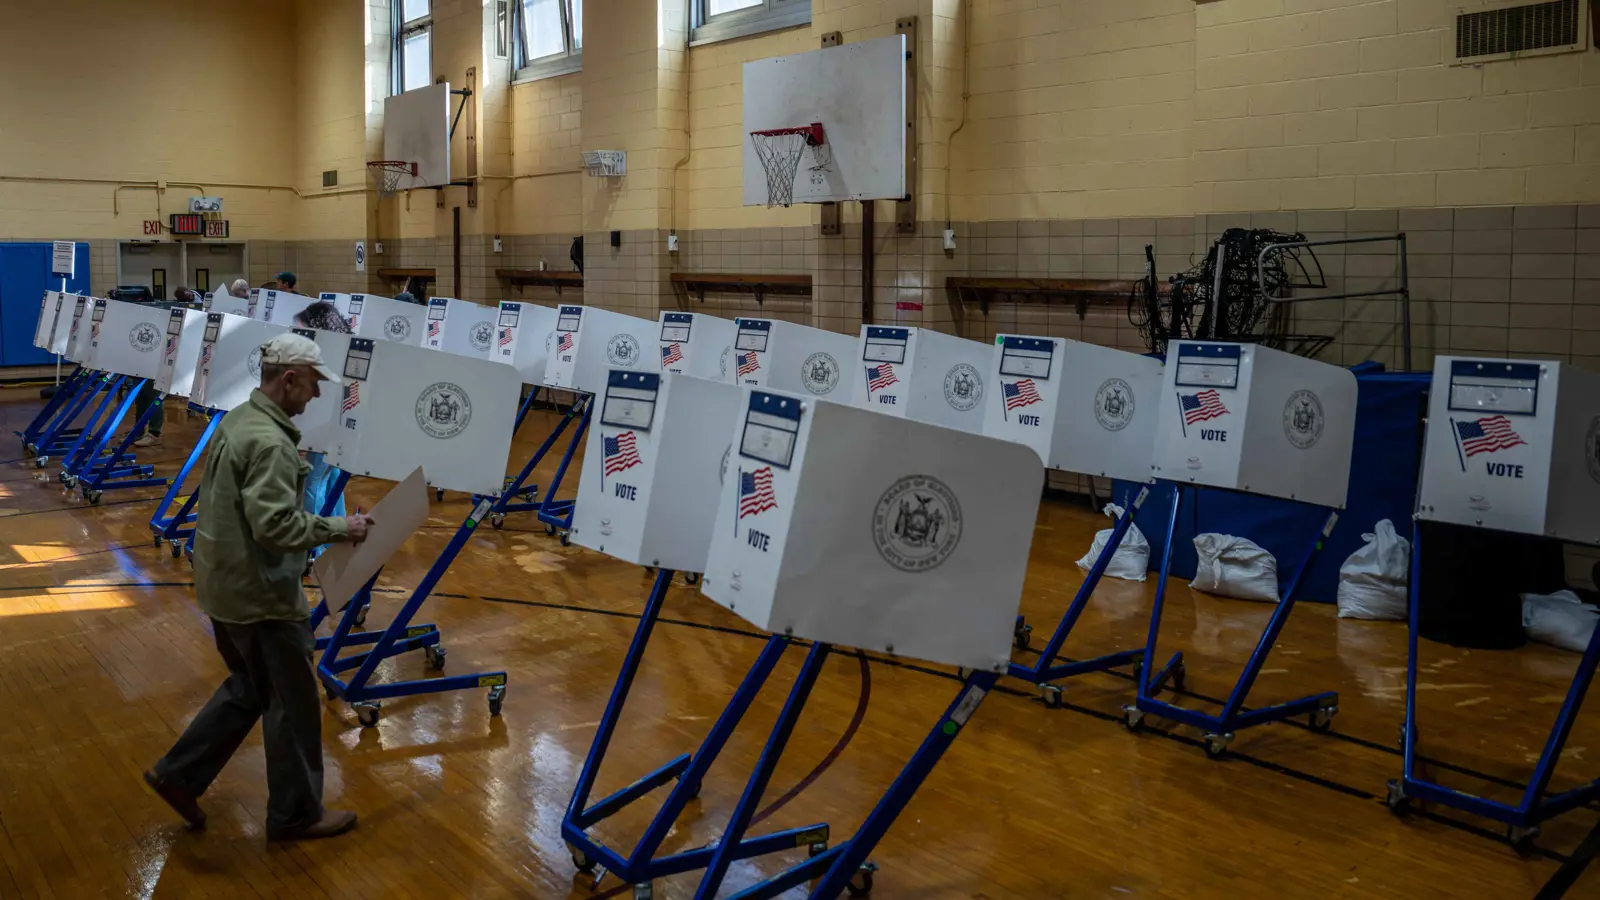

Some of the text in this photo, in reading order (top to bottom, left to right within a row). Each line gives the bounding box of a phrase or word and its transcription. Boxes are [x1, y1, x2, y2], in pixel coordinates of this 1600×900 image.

[143, 220, 162, 235] EXIT
[208, 222, 224, 236] EXIT
[879, 394, 896, 405] VOTE
[1018, 414, 1040, 426] VOTE
[1200, 428, 1227, 442] VOTE
[1486, 462, 1524, 478] VOTE
[616, 482, 637, 501] VOTE
[748, 528, 770, 552] VOTE
